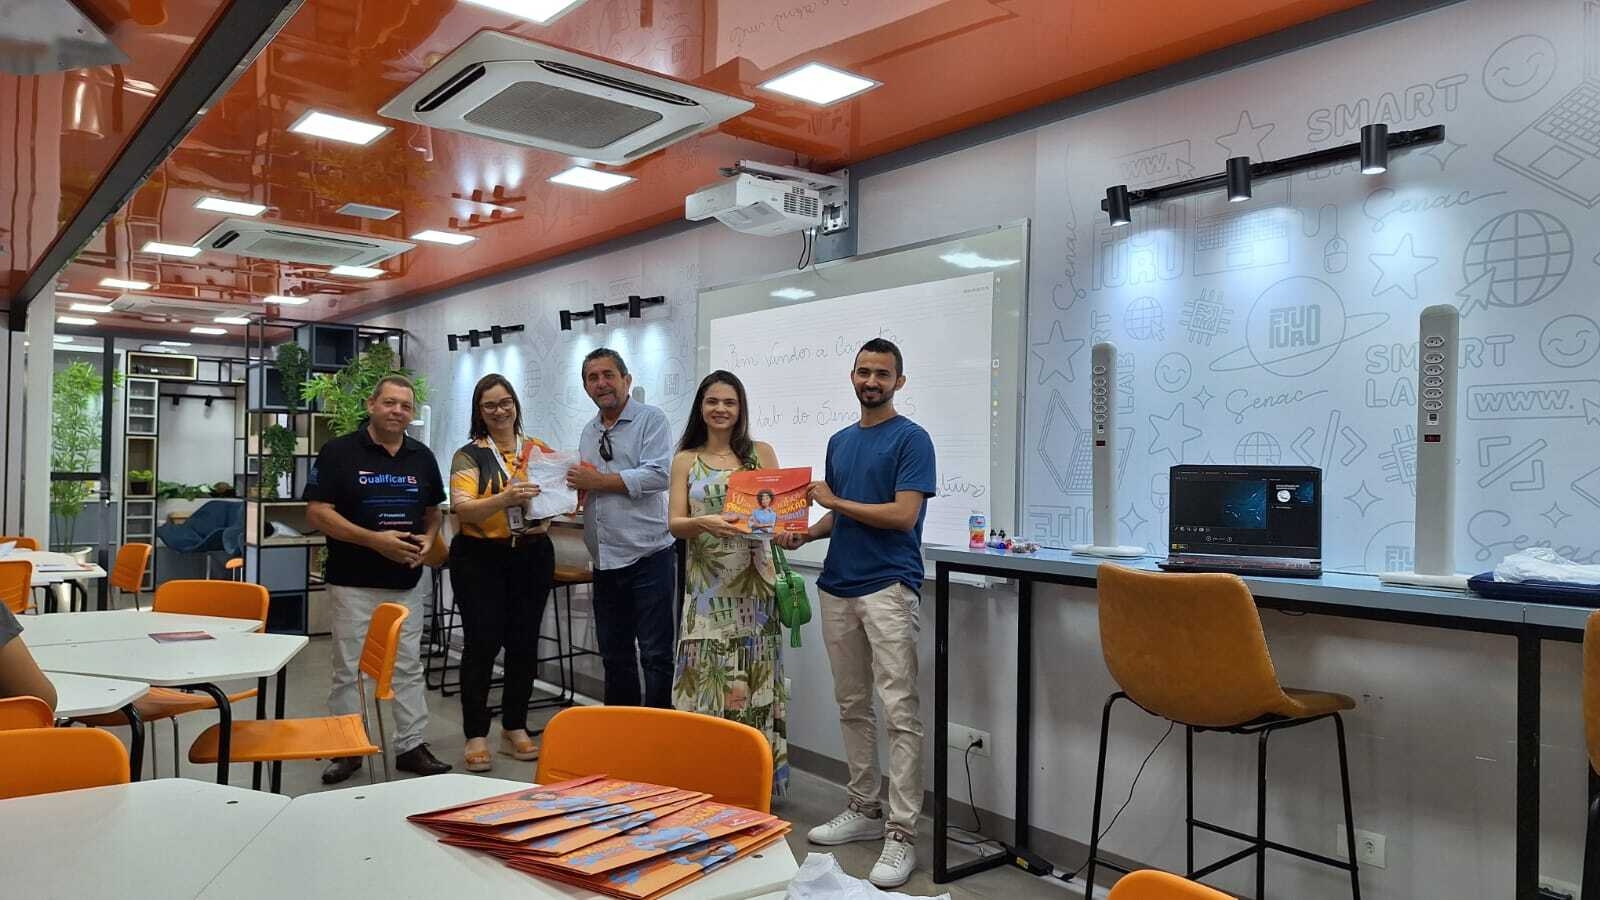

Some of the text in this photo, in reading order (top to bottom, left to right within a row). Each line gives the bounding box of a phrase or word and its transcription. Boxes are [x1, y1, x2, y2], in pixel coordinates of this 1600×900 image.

[1307, 73, 1469, 143] SMART
[1365, 335, 1516, 374] SMRT
[1225, 388, 1328, 424] Senac
[1365, 377, 1416, 408] LA
